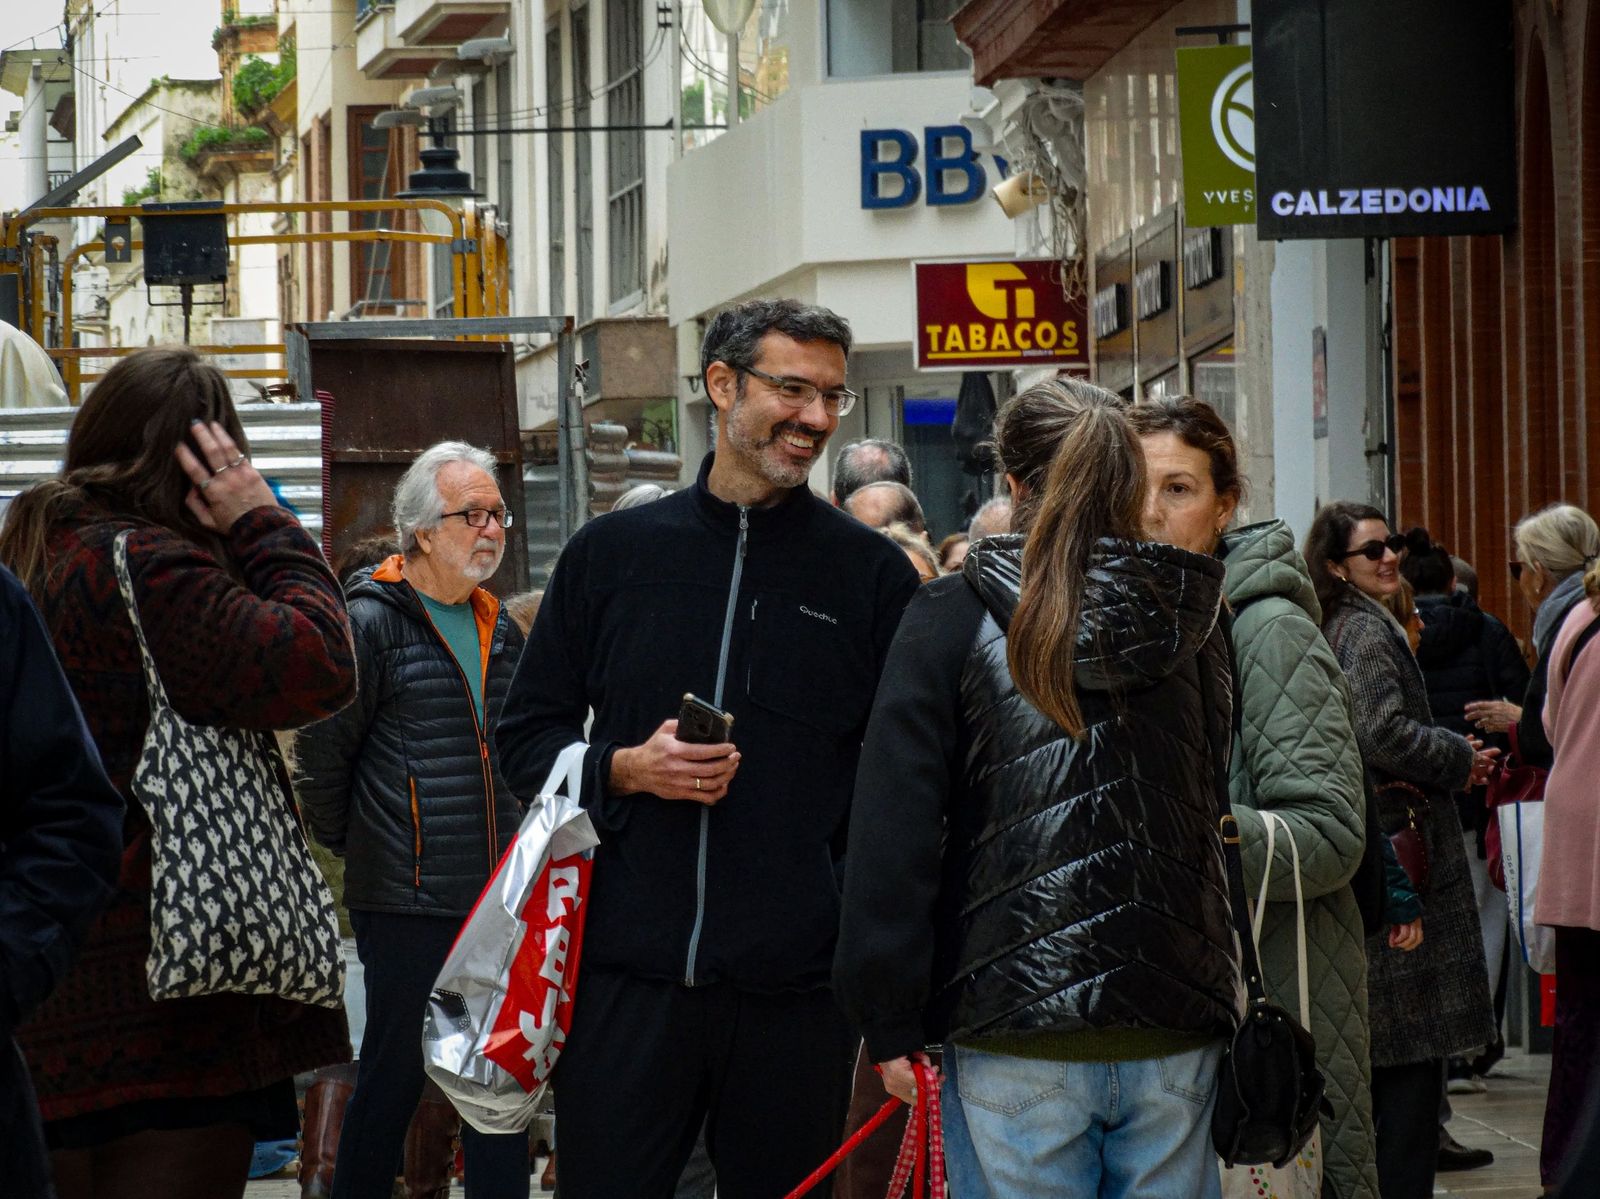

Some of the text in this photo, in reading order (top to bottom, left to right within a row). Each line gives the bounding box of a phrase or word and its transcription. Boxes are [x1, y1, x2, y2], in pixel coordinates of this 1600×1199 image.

[861, 125, 1008, 209] BB
[1203, 188, 1253, 204] YVES
[1271, 186, 1491, 216] CALZEDONIA
[926, 320, 1079, 352] TABACOS
